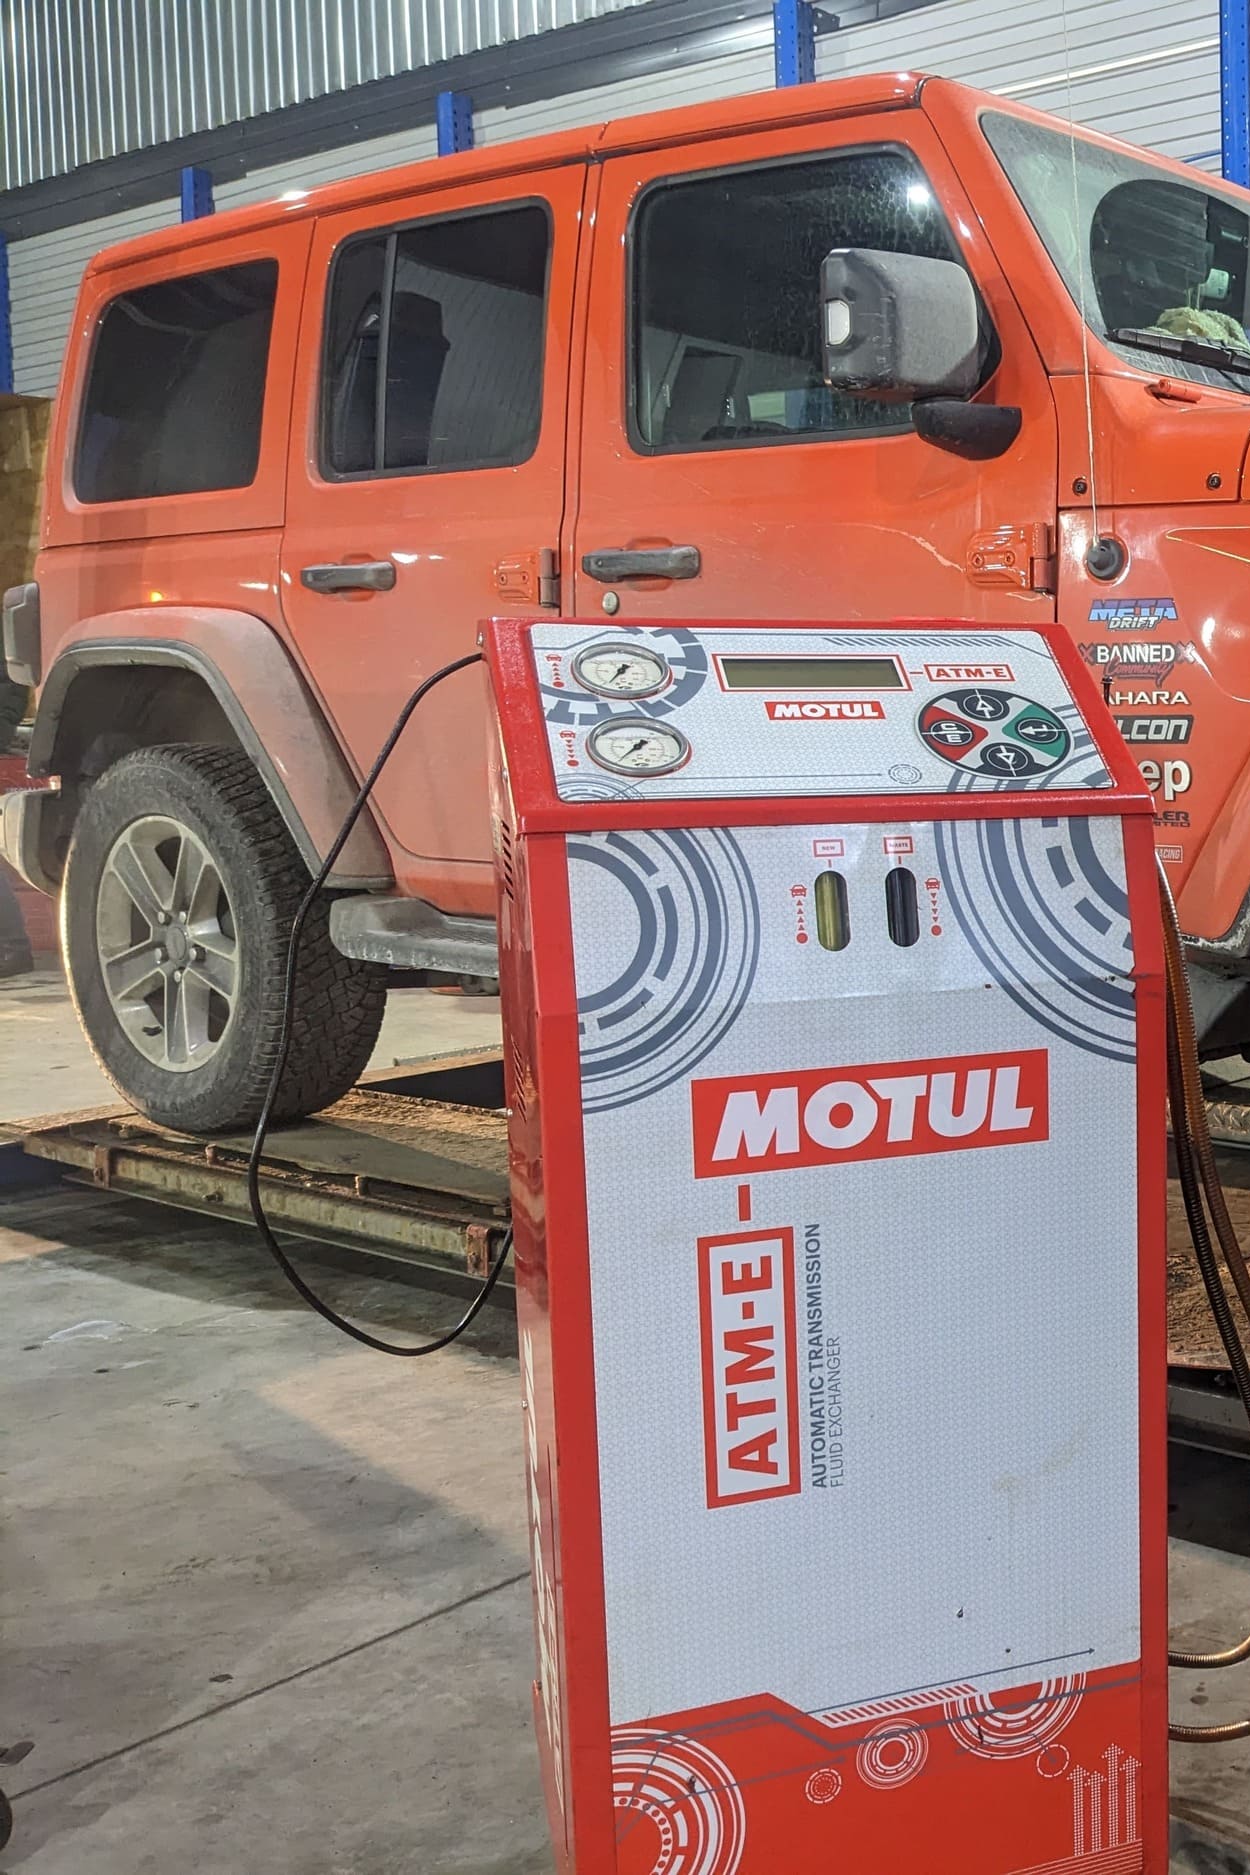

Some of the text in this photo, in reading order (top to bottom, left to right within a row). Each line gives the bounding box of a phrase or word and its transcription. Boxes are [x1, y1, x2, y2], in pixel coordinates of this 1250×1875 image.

[1089, 599, 1178, 620] META
[1108, 616, 1158, 630] DRIFT
[1096, 644, 1175, 663] BANNED
[935, 668, 1008, 678] ATM-E
[774, 703, 879, 718] MOTUL
[711, 1065, 1034, 1162] MOTUL
[721, 1255, 779, 1476] ATM-E
[805, 1223, 827, 1488] AUTOMATIC TRANSMISSION
[826, 1336, 844, 1488] FLUID EXCHANGER
